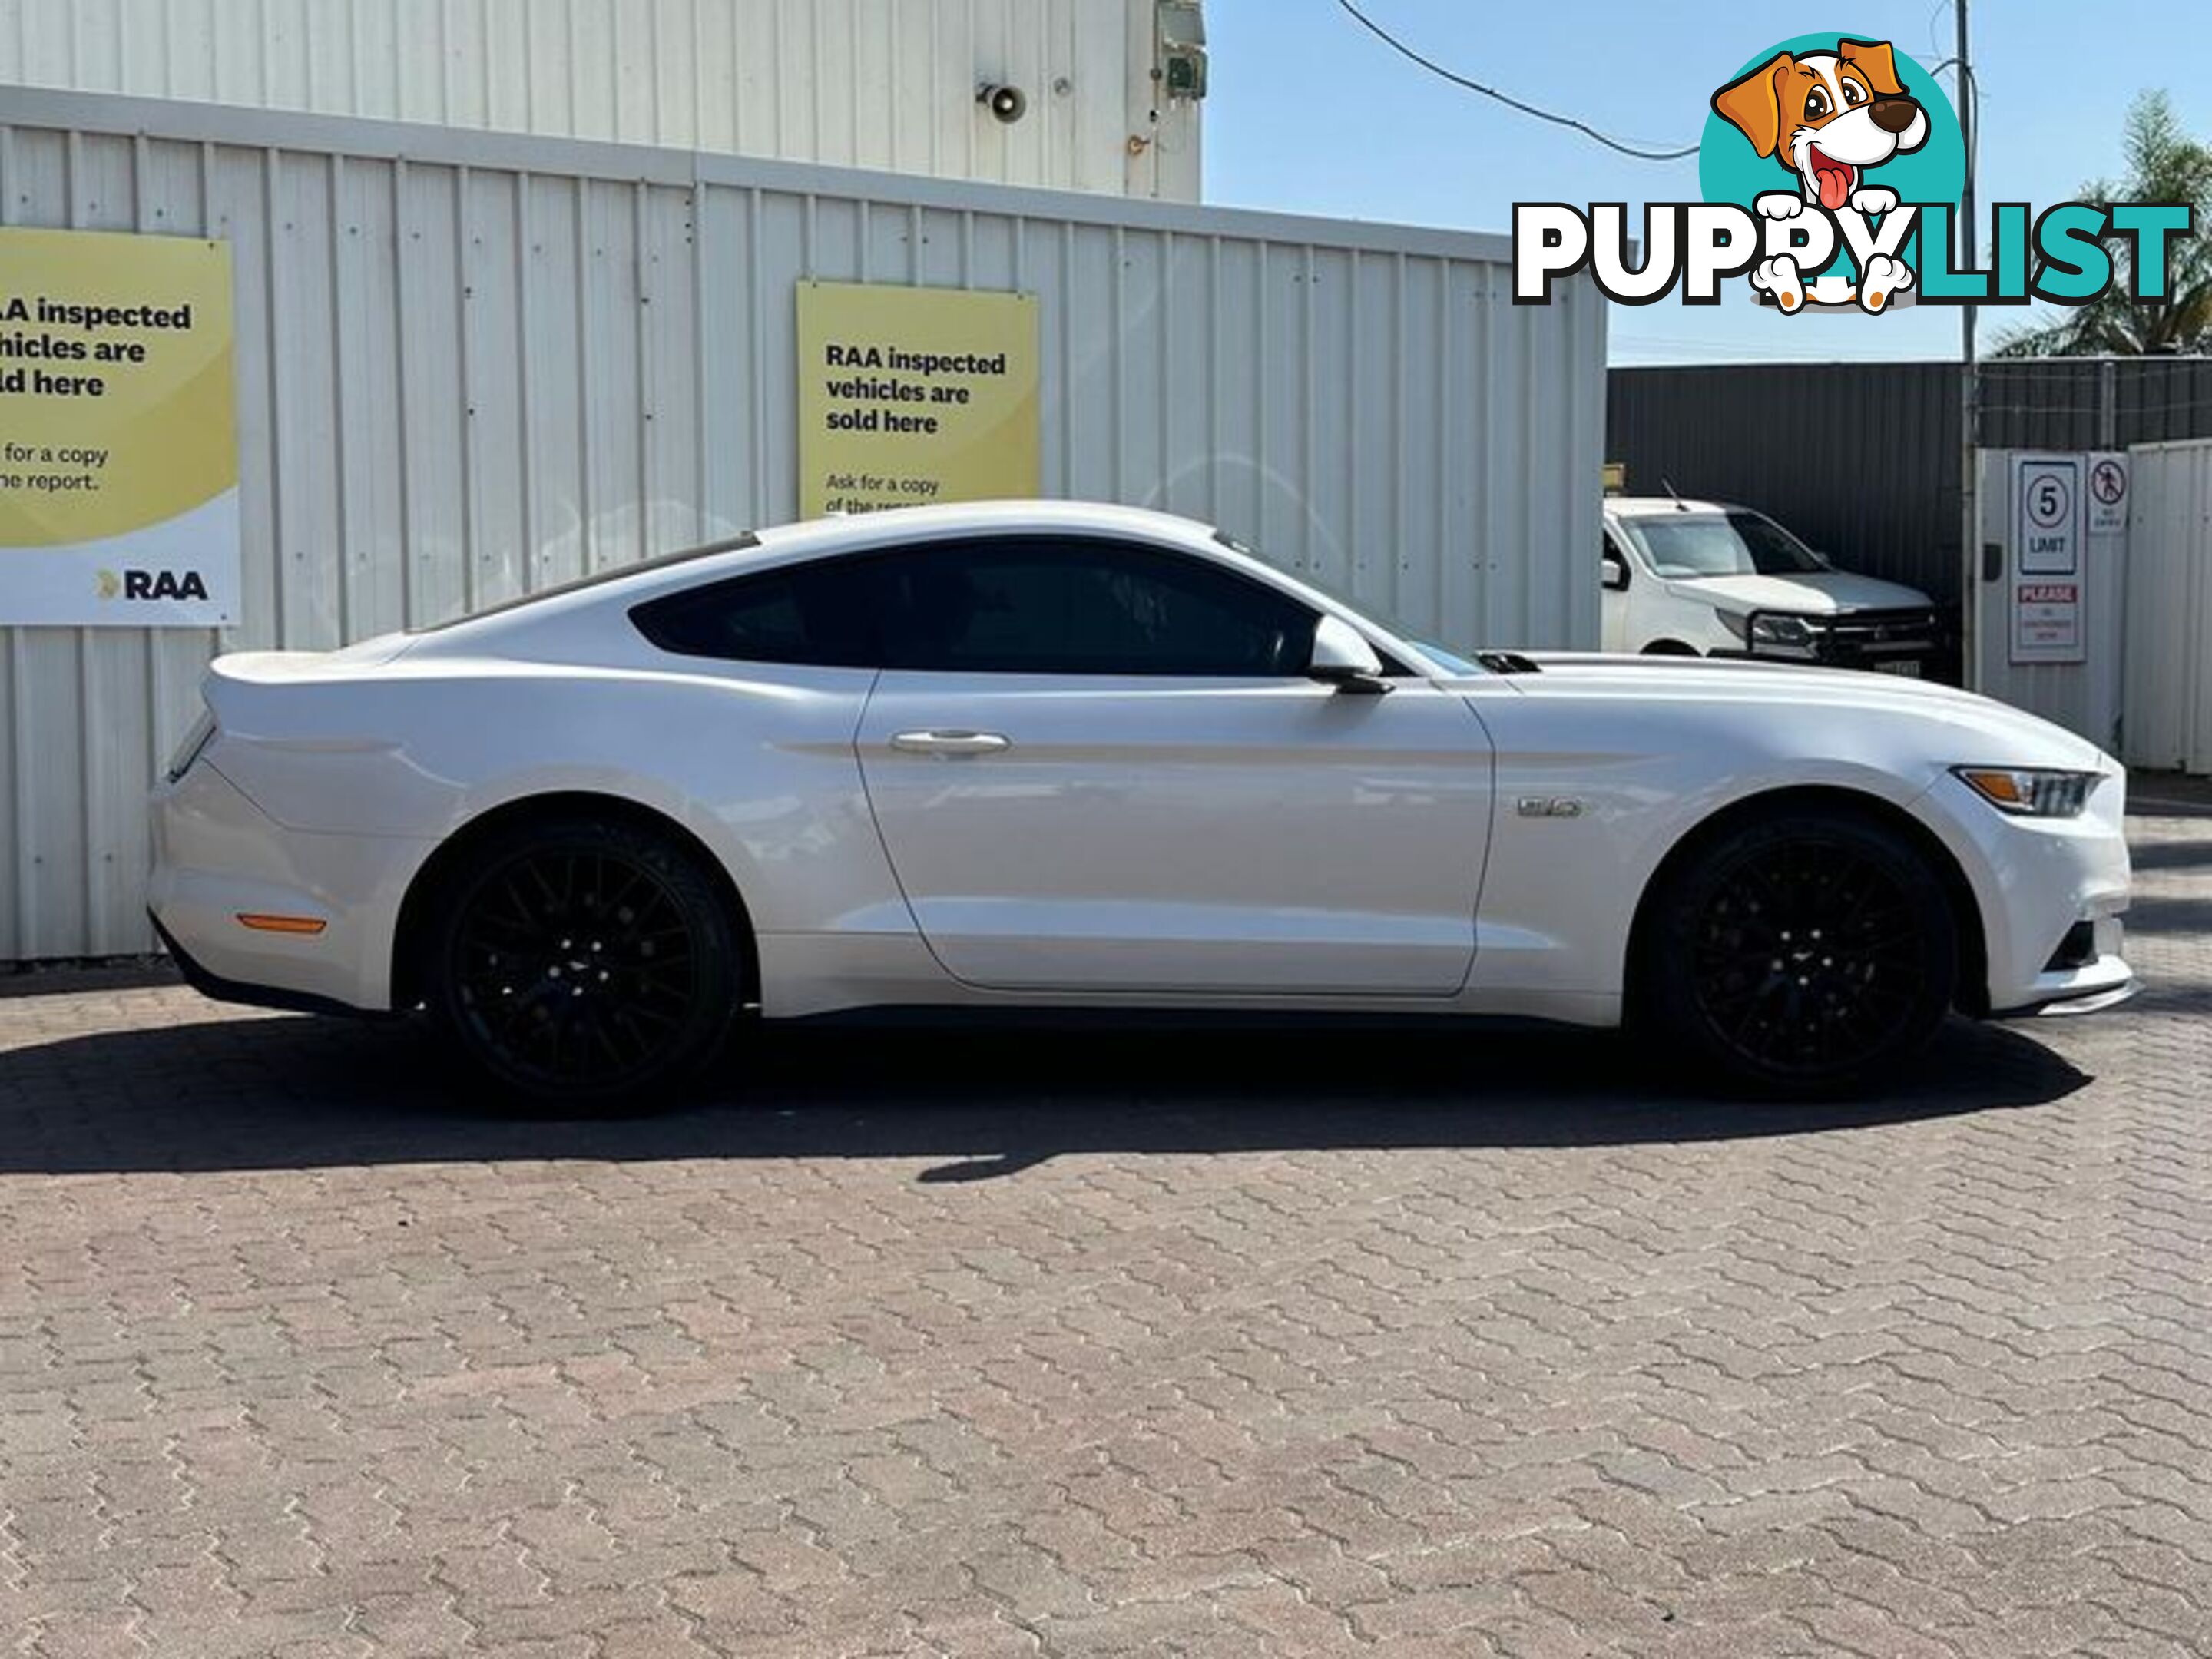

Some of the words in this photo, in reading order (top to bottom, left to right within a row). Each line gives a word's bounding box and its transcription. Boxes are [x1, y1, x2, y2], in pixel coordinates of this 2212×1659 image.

[38, 297, 191, 330] inspected
[94, 343, 145, 362] are
[826, 346, 882, 368] RAA
[889, 347, 1005, 376] inspected
[34, 369, 104, 396] here
[826, 378, 925, 402] vehicles
[930, 387, 969, 405] are
[826, 409, 878, 432] sold
[884, 410, 938, 434] here
[5, 442, 35, 462] for
[41, 448, 53, 462] a
[58, 449, 108, 468] copy
[826, 473, 857, 490] Ask
[861, 474, 883, 490] for
[887, 478, 897, 492] a
[901, 478, 940, 496] copy
[826, 498, 843, 512] of
[2039, 486, 2057, 517] 5
[2029, 537, 2065, 553] LIMIT
[124, 571, 207, 601] RAA
